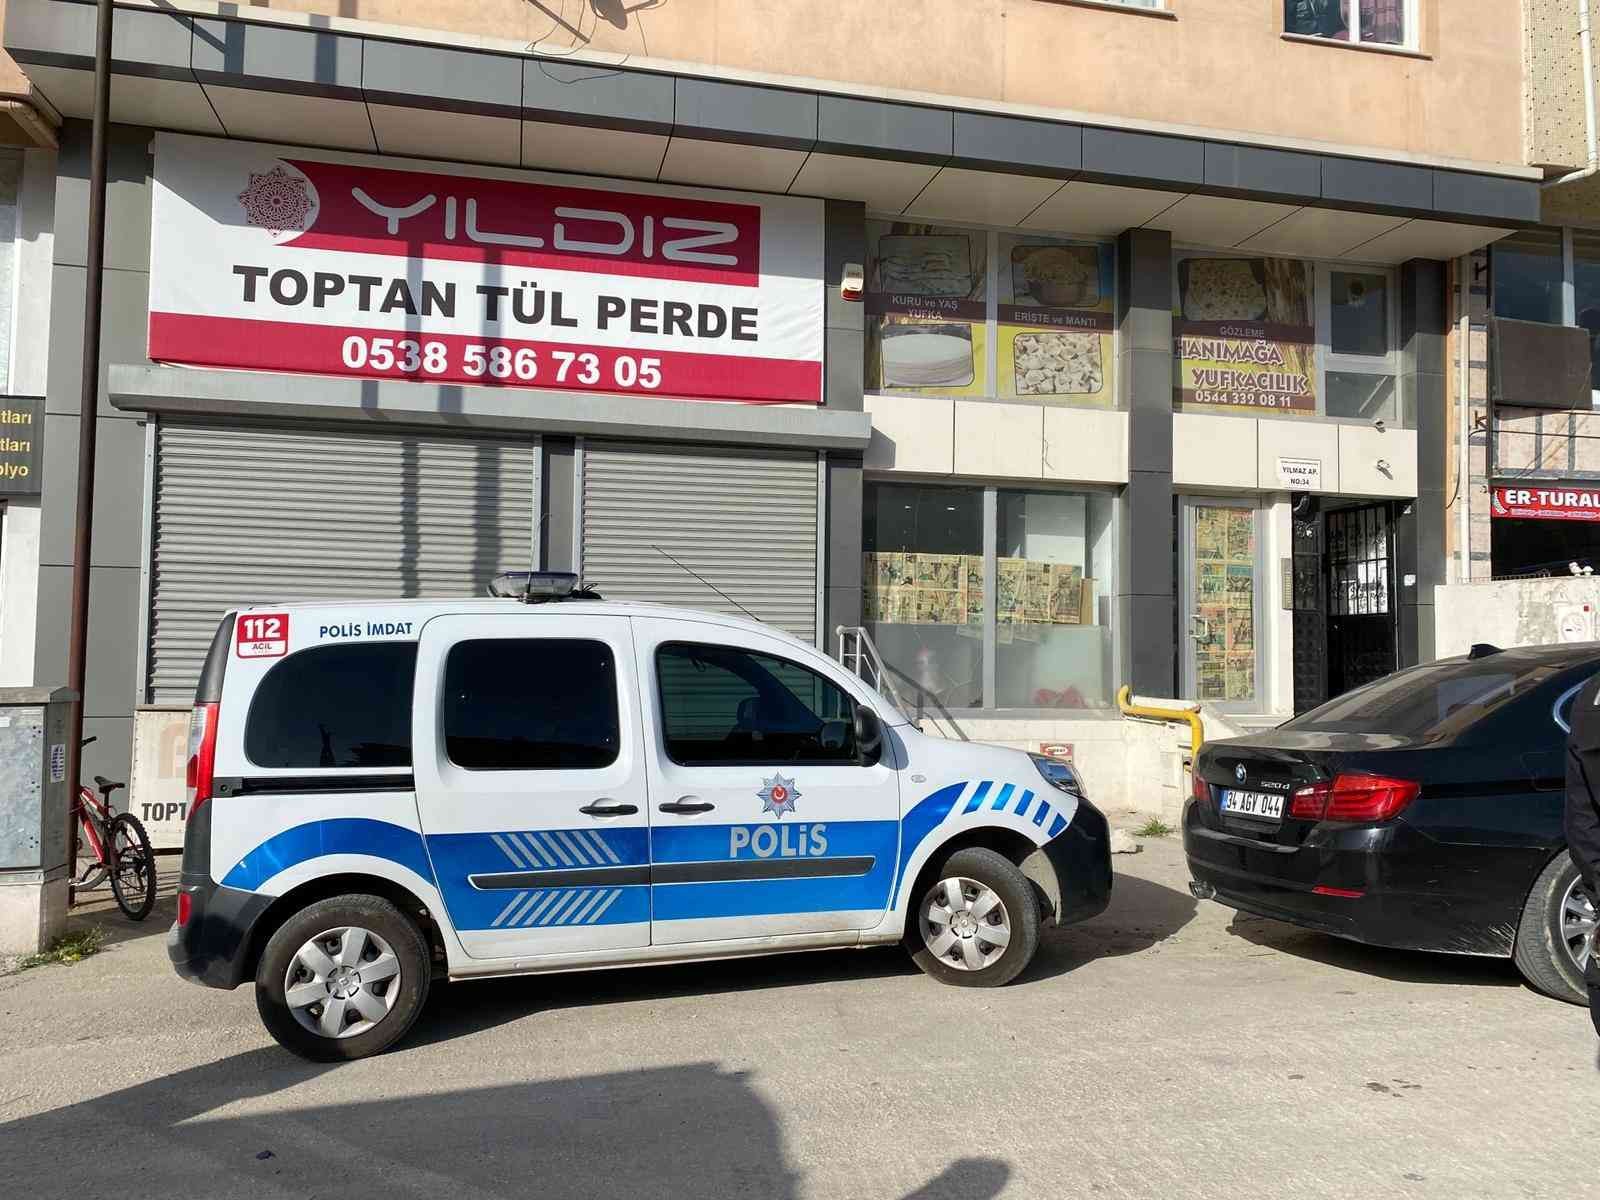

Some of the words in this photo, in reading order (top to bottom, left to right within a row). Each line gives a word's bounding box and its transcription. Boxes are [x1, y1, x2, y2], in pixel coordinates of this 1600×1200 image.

[352, 187, 738, 266] YILDIZ
[233, 265, 456, 318] TOPTAN
[476, 280, 578, 328] TÜL
[597, 295, 759, 342] PERDE
[892, 295, 922, 306] KURU
[908, 309, 943, 320] YUFKA
[342, 335, 448, 374] 0538
[462, 344, 538, 380] 586
[551, 351, 600, 386] 73
[614, 356, 662, 388] 05
[1175, 340, 1283, 365] HANIMAĞA
[1191, 367, 1308, 396] YUFKACILIK
[1195, 391, 1228, 403] 0544
[1260, 394, 1276, 406] 08
[1280, 396, 1291, 408] 11
[243, 618, 281, 639] 112
[1226, 791, 1237, 809] 34
[1240, 793, 1259, 812] AGY
[1261, 796, 1280, 816] 044
